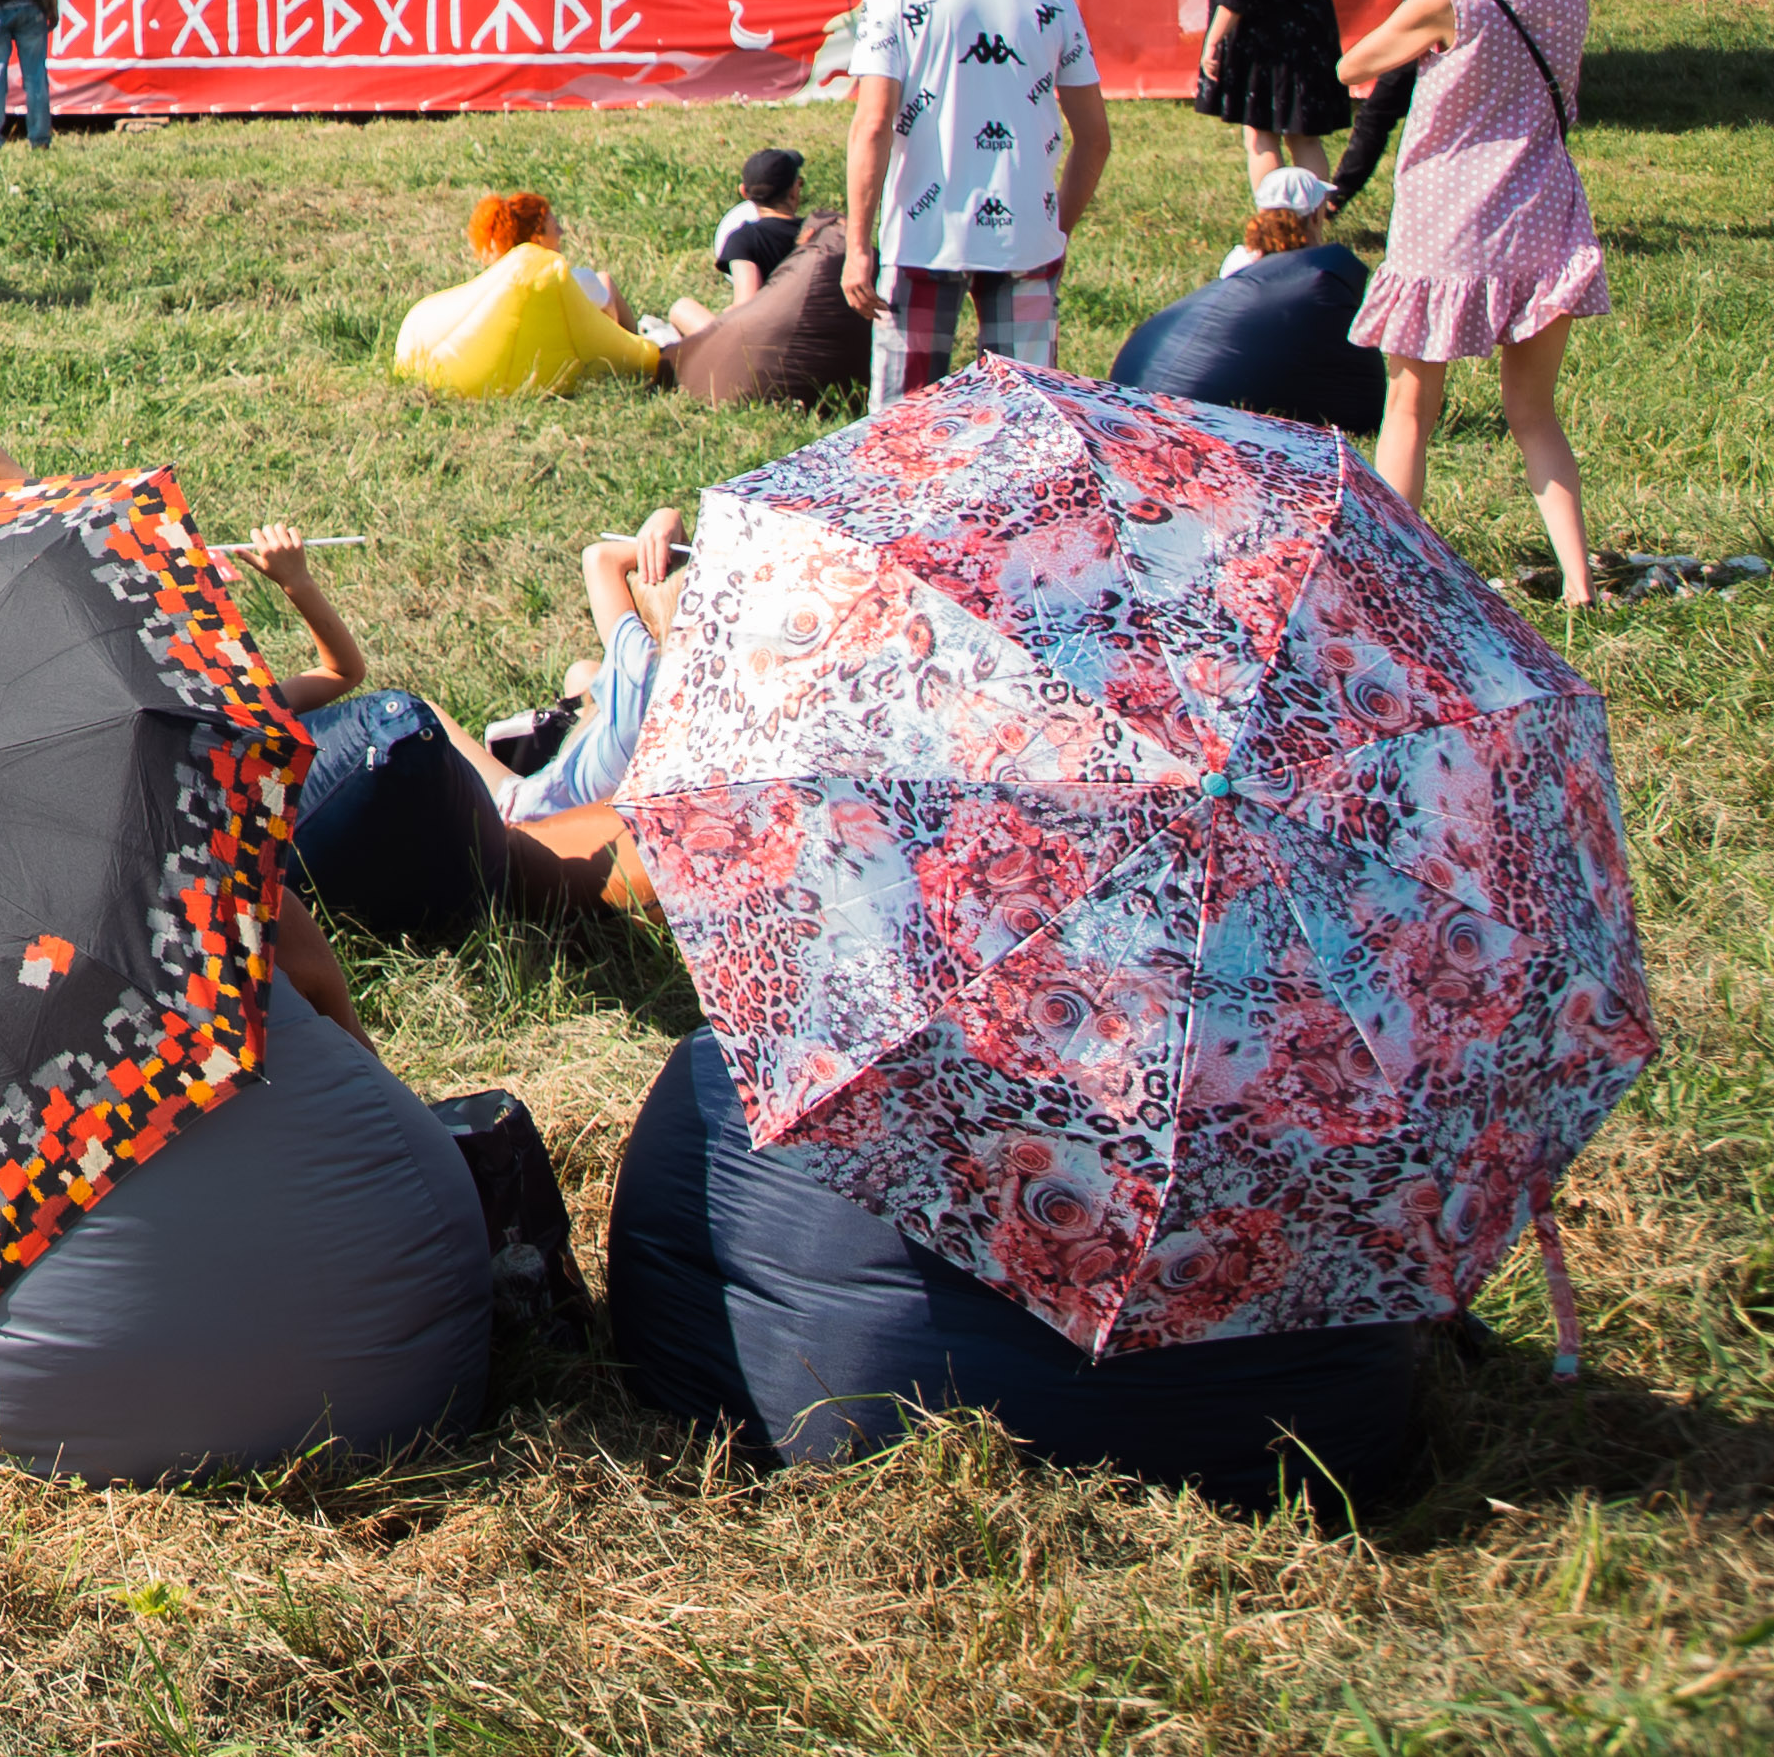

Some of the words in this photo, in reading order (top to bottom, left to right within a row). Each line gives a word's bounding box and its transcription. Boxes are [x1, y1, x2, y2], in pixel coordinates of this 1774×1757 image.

[895, 88, 936, 137] Kappa
[976, 138, 1013, 151] Kappa
[907, 182, 941, 221] Kappa
[975, 214, 1013, 229] Kappa
